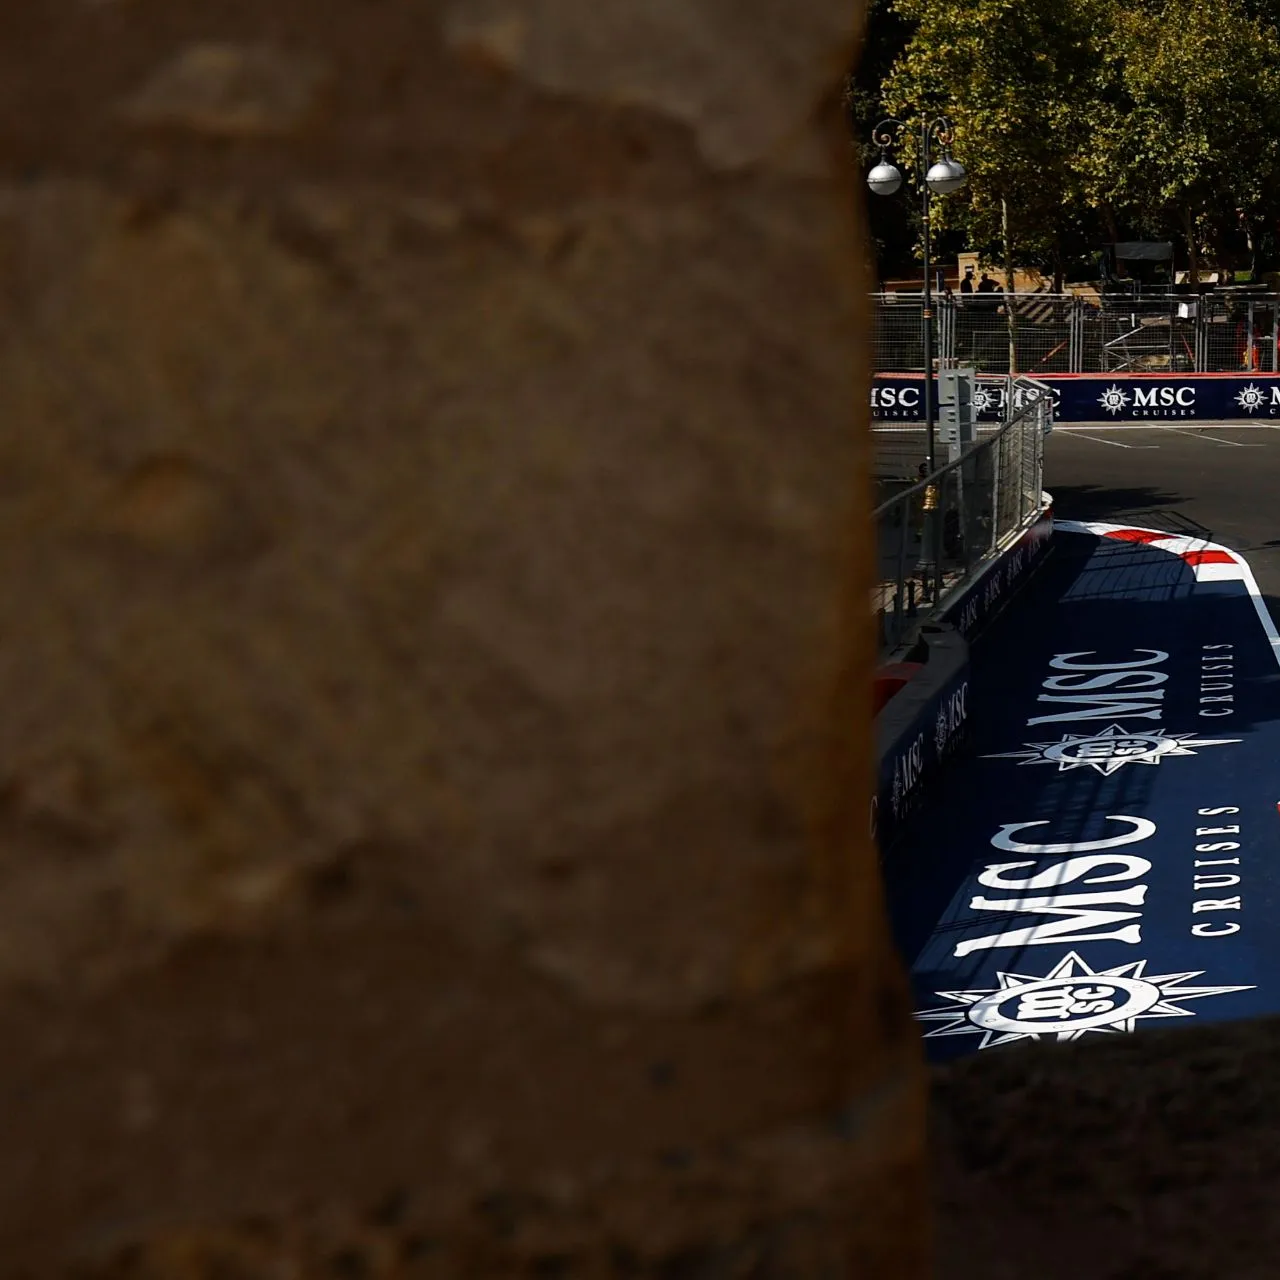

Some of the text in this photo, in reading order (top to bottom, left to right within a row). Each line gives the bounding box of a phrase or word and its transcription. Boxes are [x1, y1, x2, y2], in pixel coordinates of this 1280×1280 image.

[1133, 387, 1196, 407] MSC
[948, 681, 968, 732] MSC
[1026, 648, 1169, 726] MSC
[1199, 644, 1234, 717] CRUISES
[902, 732, 924, 796] MSC
[953, 815, 1157, 957] MSC
[1191, 806, 1241, 937] CRUISES
